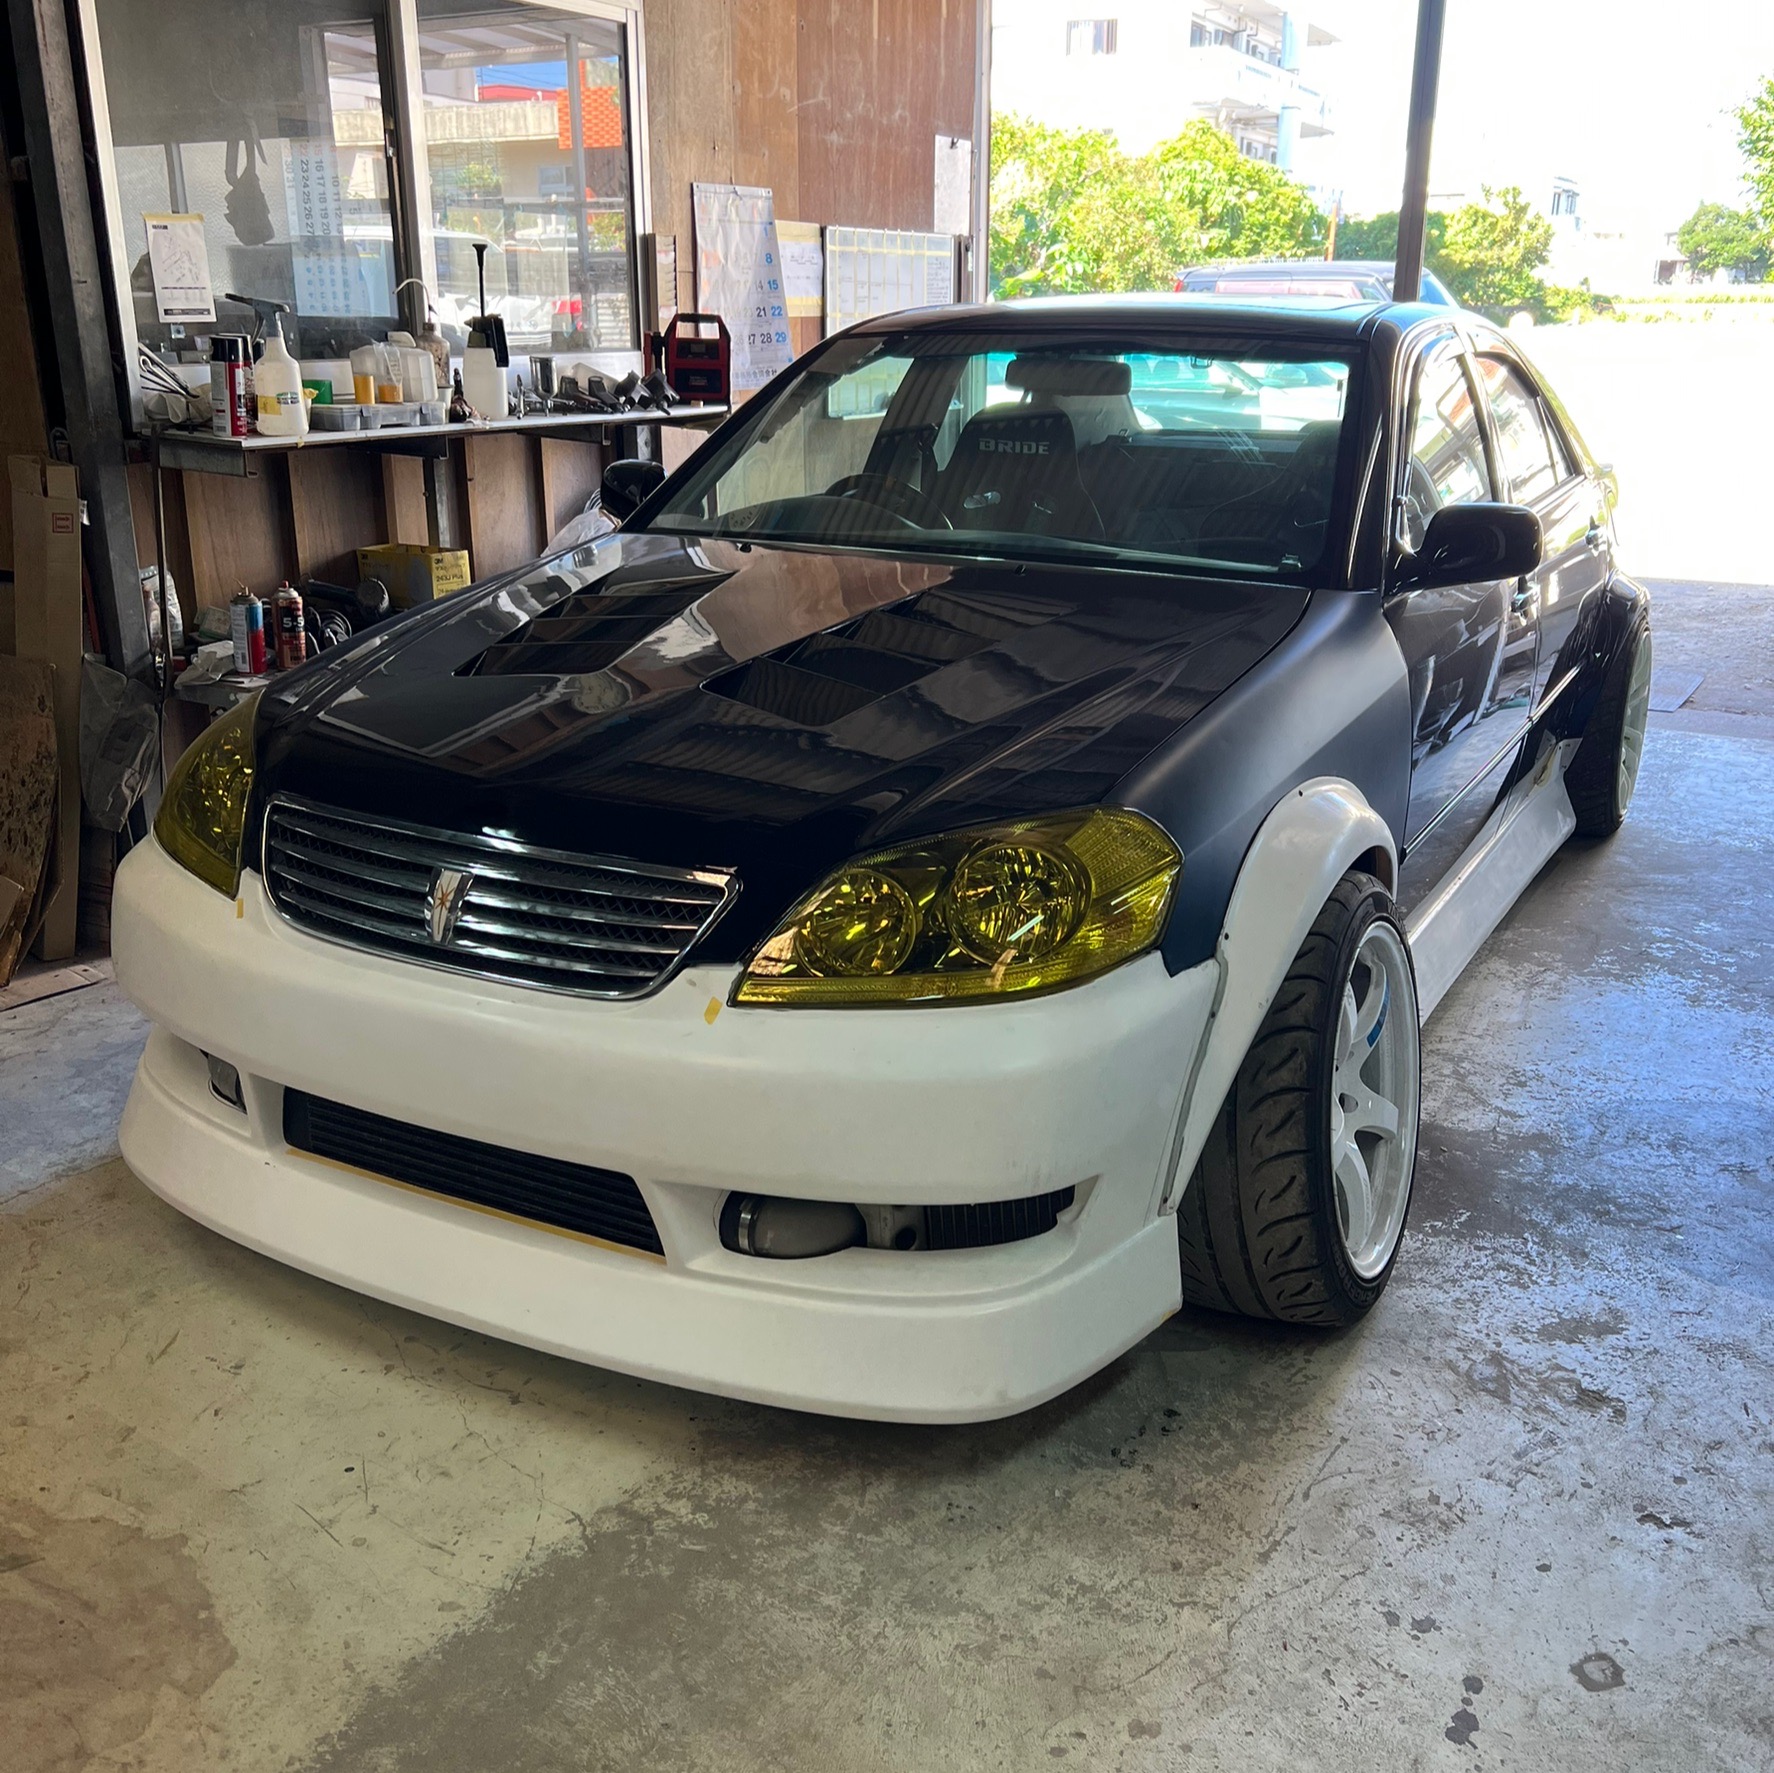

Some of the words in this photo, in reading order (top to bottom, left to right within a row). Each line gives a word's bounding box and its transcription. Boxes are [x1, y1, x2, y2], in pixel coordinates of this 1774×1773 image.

[300, 159, 309, 173] 23
[315, 159, 324, 173] 16
[302, 175, 310, 188] 24
[317, 175, 325, 188] 17
[303, 191, 311, 204] 25
[318, 191, 327, 204] 18
[304, 207, 313, 220] 26
[320, 207, 329, 219] 19
[305, 222, 314, 235] 27
[322, 222, 331, 235] 20
[765, 252, 773, 264] 8
[767, 279, 779, 291] 15
[756, 306, 767, 318] 21
[771, 305, 783, 316] 22
[760, 332, 772, 344] 28
[775, 331, 787, 343] 29
[979, 438, 1050, 455] BRIDE
